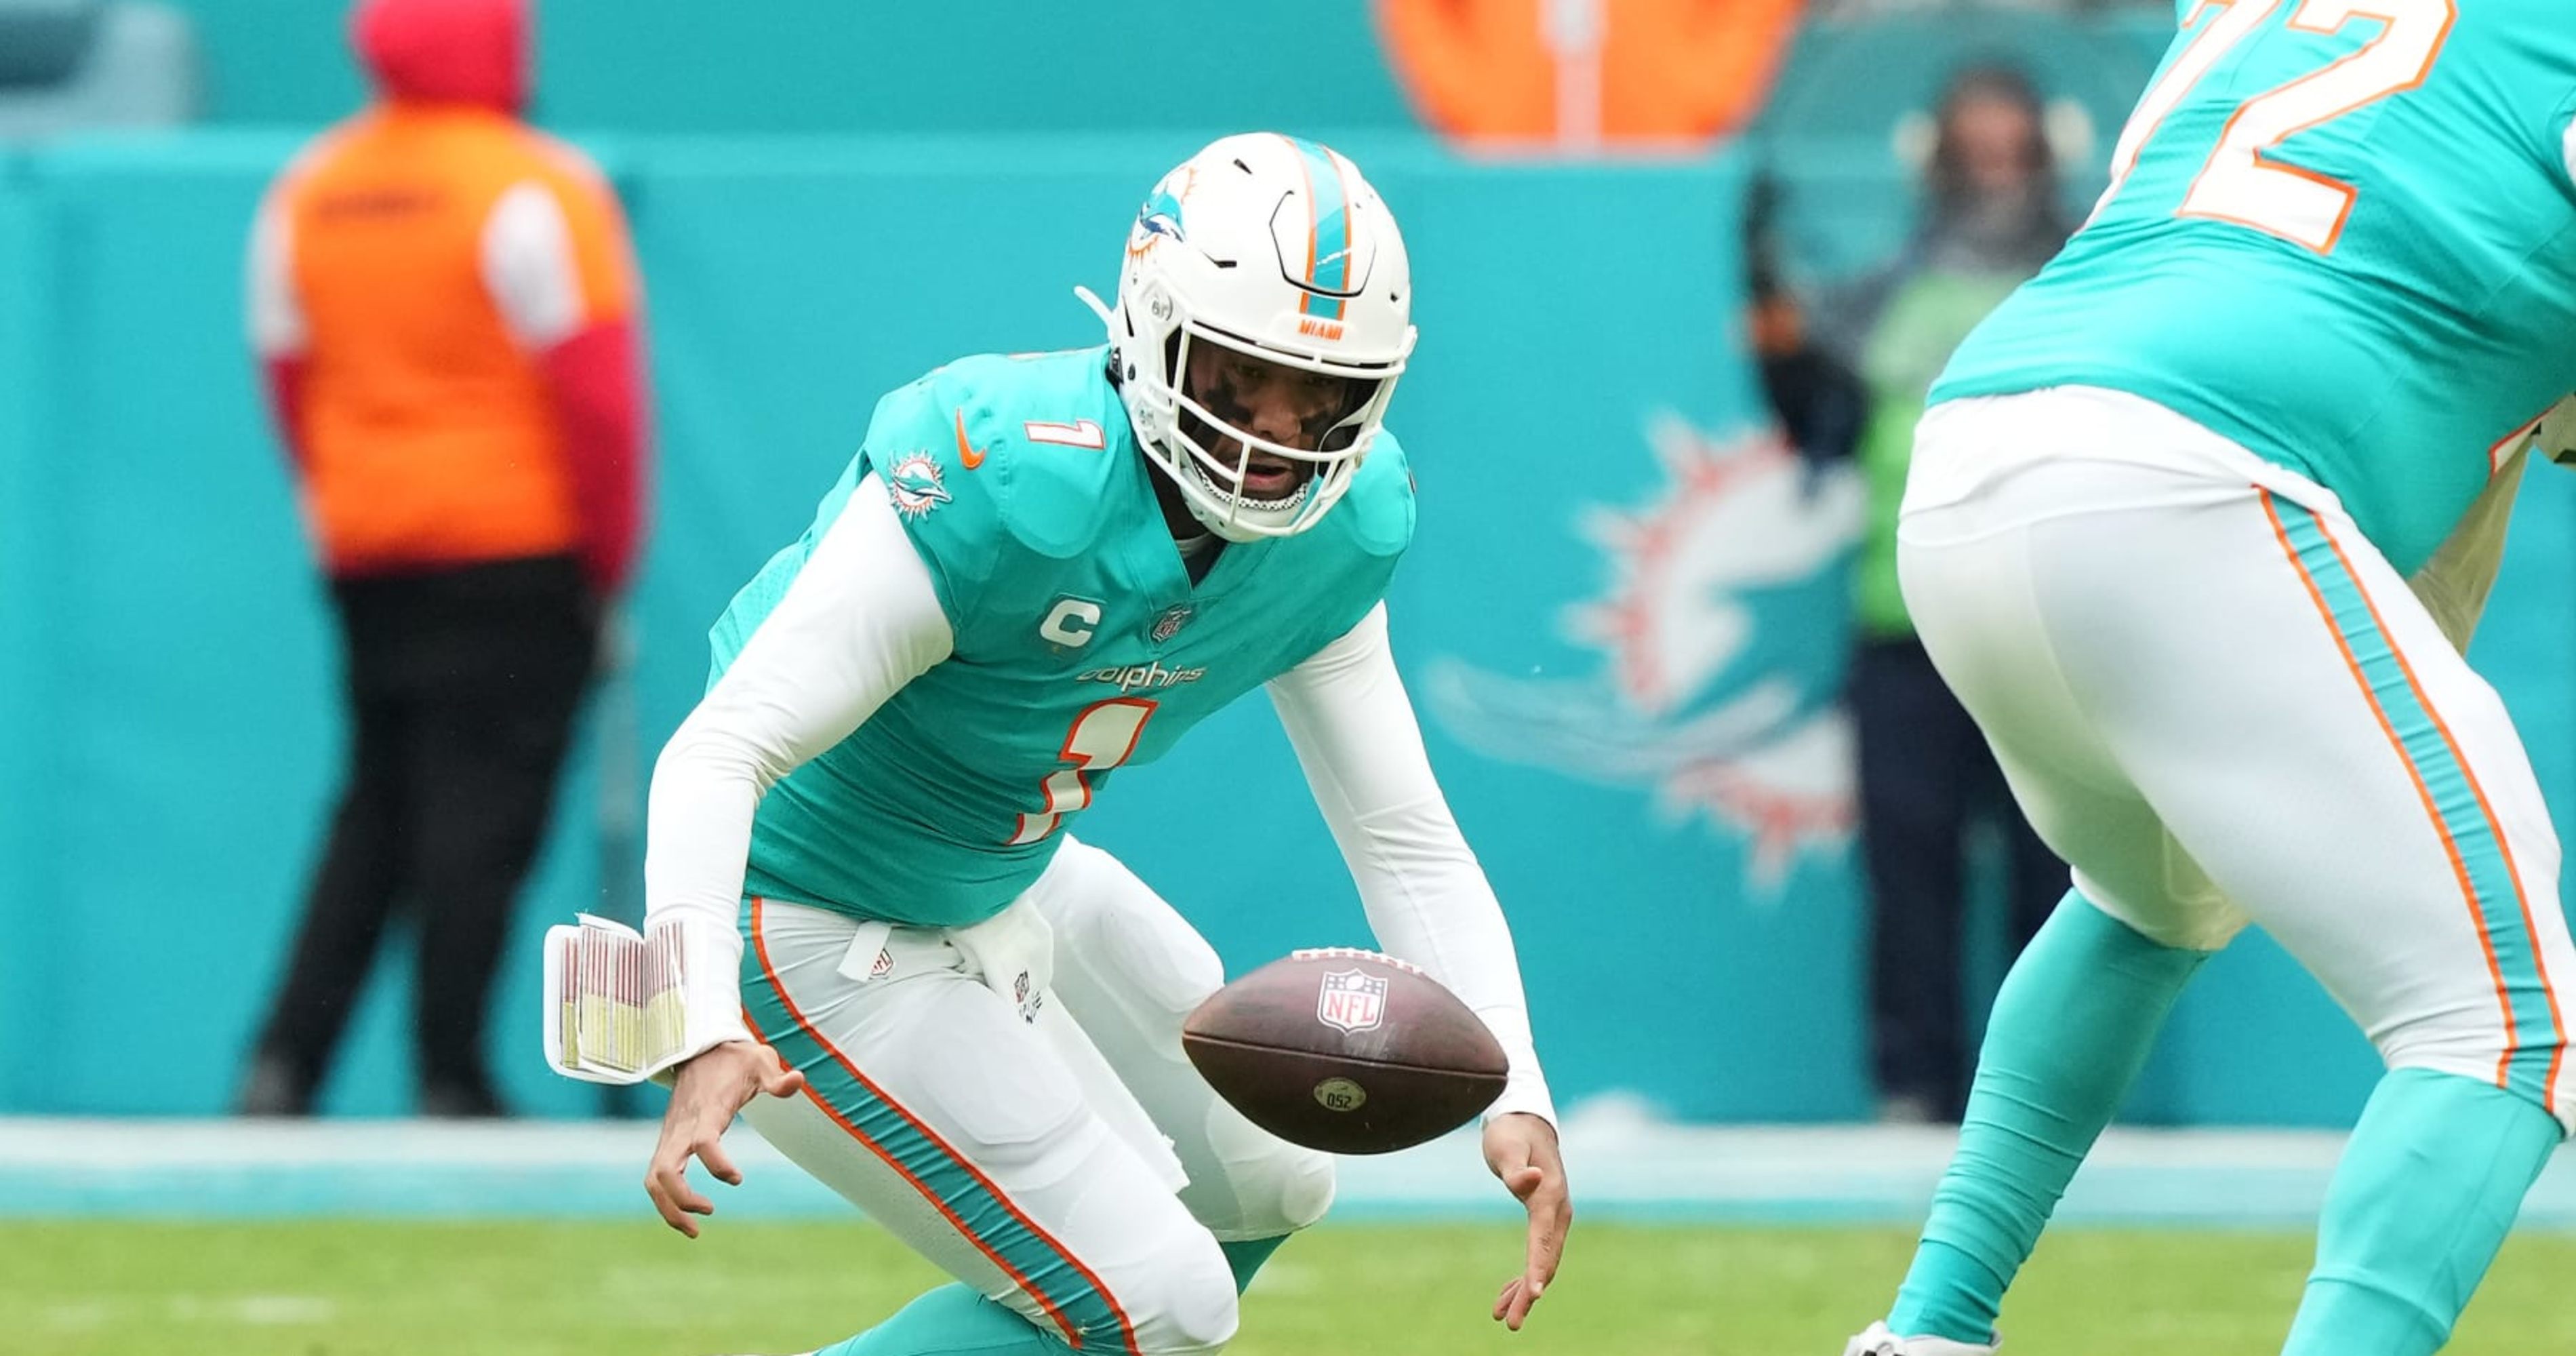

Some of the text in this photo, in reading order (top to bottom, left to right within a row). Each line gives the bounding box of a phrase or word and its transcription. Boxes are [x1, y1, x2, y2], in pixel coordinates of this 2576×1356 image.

[1298, 319, 1344, 341] MIAMI
[1024, 420, 1106, 450] 1
[1040, 599, 1101, 647] C
[1005, 696, 1159, 845] 1
[1326, 993, 1375, 1024] NFL
[1327, 1092, 1352, 1110] 052
